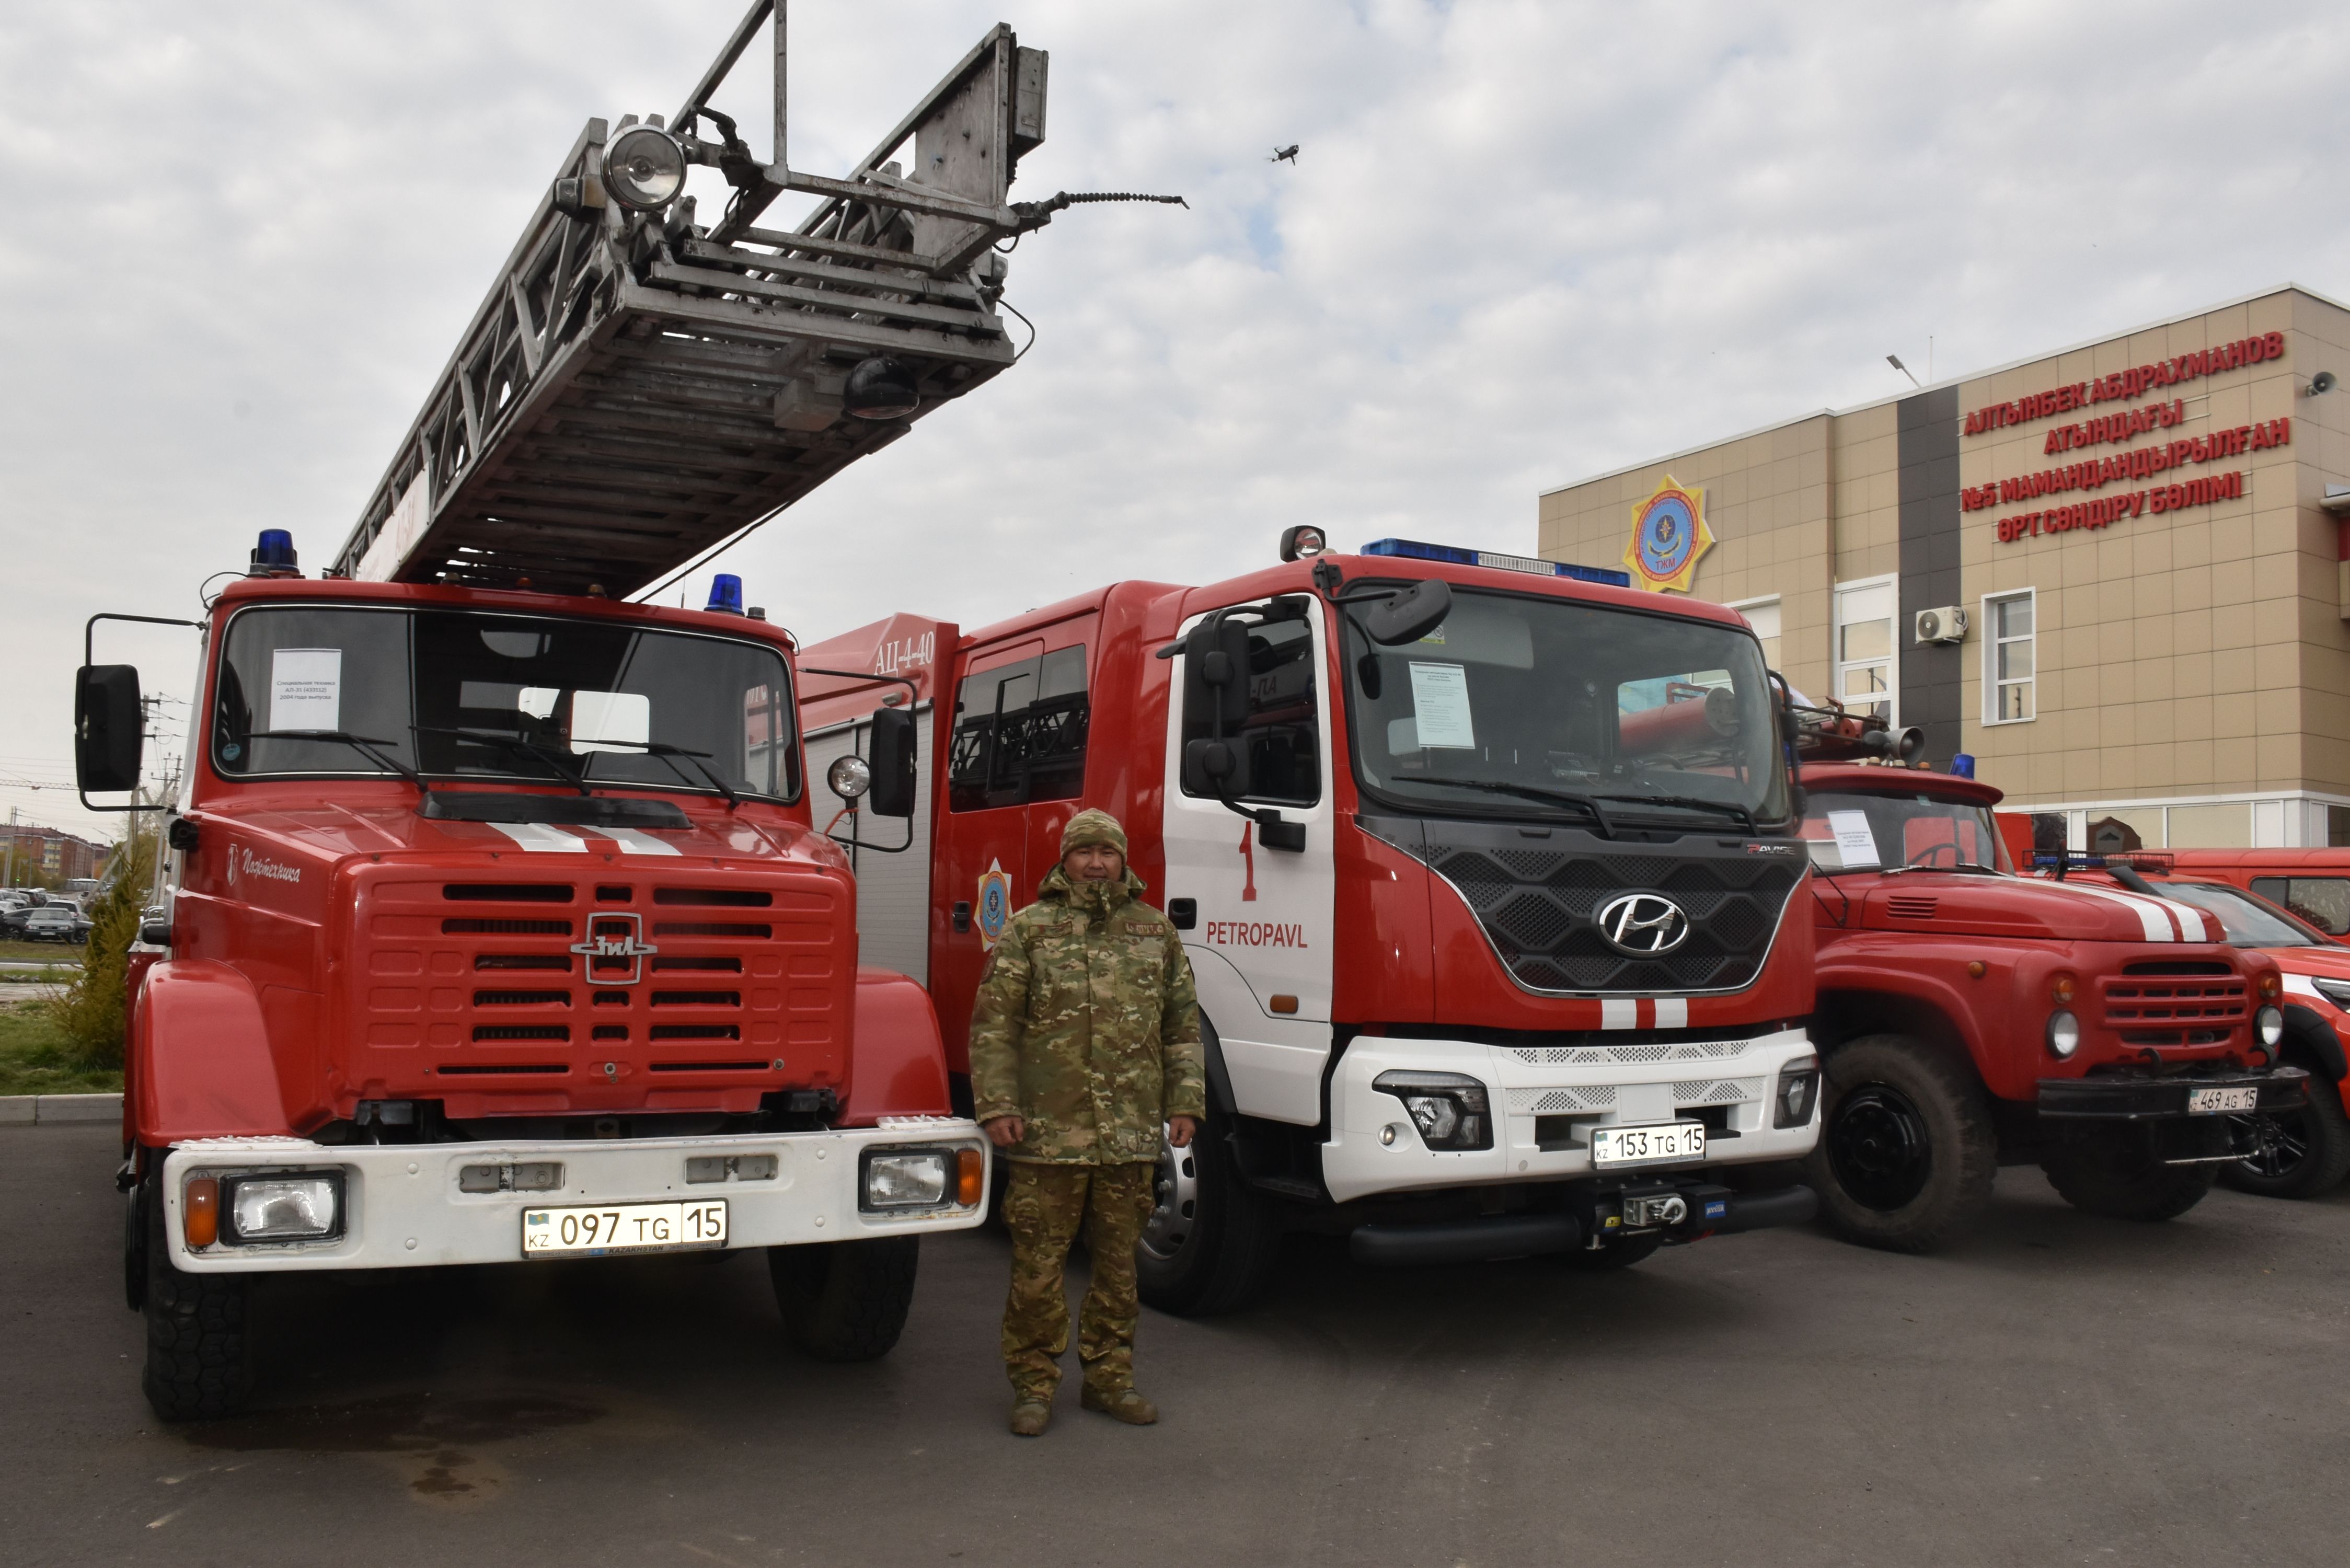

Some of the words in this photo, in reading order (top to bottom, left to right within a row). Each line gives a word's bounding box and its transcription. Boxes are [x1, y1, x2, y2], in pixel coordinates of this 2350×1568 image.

[1963, 382, 2087, 436] АЛТЫНБЕК
[2090, 331, 2284, 405] АБДРАХМАНОВ
[2044, 399, 2183, 455] АТЫНДАҒЫ
[1961, 482, 1997, 512] №5
[2000, 417, 2289, 503] МАМАНДАНДЫРЫЛҒАН
[1997, 511, 2041, 543] ӨРТ
[2043, 492, 2146, 534] СӨНДІРУ
[2150, 471, 2242, 513] БӨЛІМІ
[1655, 558, 1676, 571] ТЖМ
[874, 631, 935, 678] АЦ-4-40
[243, 848, 301, 883] Пожтехника
[1239, 821, 1257, 902] 1
[1747, 844, 1795, 855] PAVISE
[1207, 921, 1308, 948] PETROPAVL
[2201, 1091, 2221, 1109] 469
[2224, 1095, 2238, 1108] AG
[2243, 1090, 2256, 1109] 15
[1596, 1149, 1608, 1159] KZ
[1616, 1132, 1648, 1157] 153
[1654, 1136, 1675, 1154] TG
[1684, 1128, 1703, 1151] 15
[528, 1235, 549, 1248] KZ
[560, 1213, 620, 1245] 097
[632, 1217, 669, 1242] TG
[687, 1207, 722, 1238] 15
[608, 1245, 664, 1254] KAZAKHSTAN
